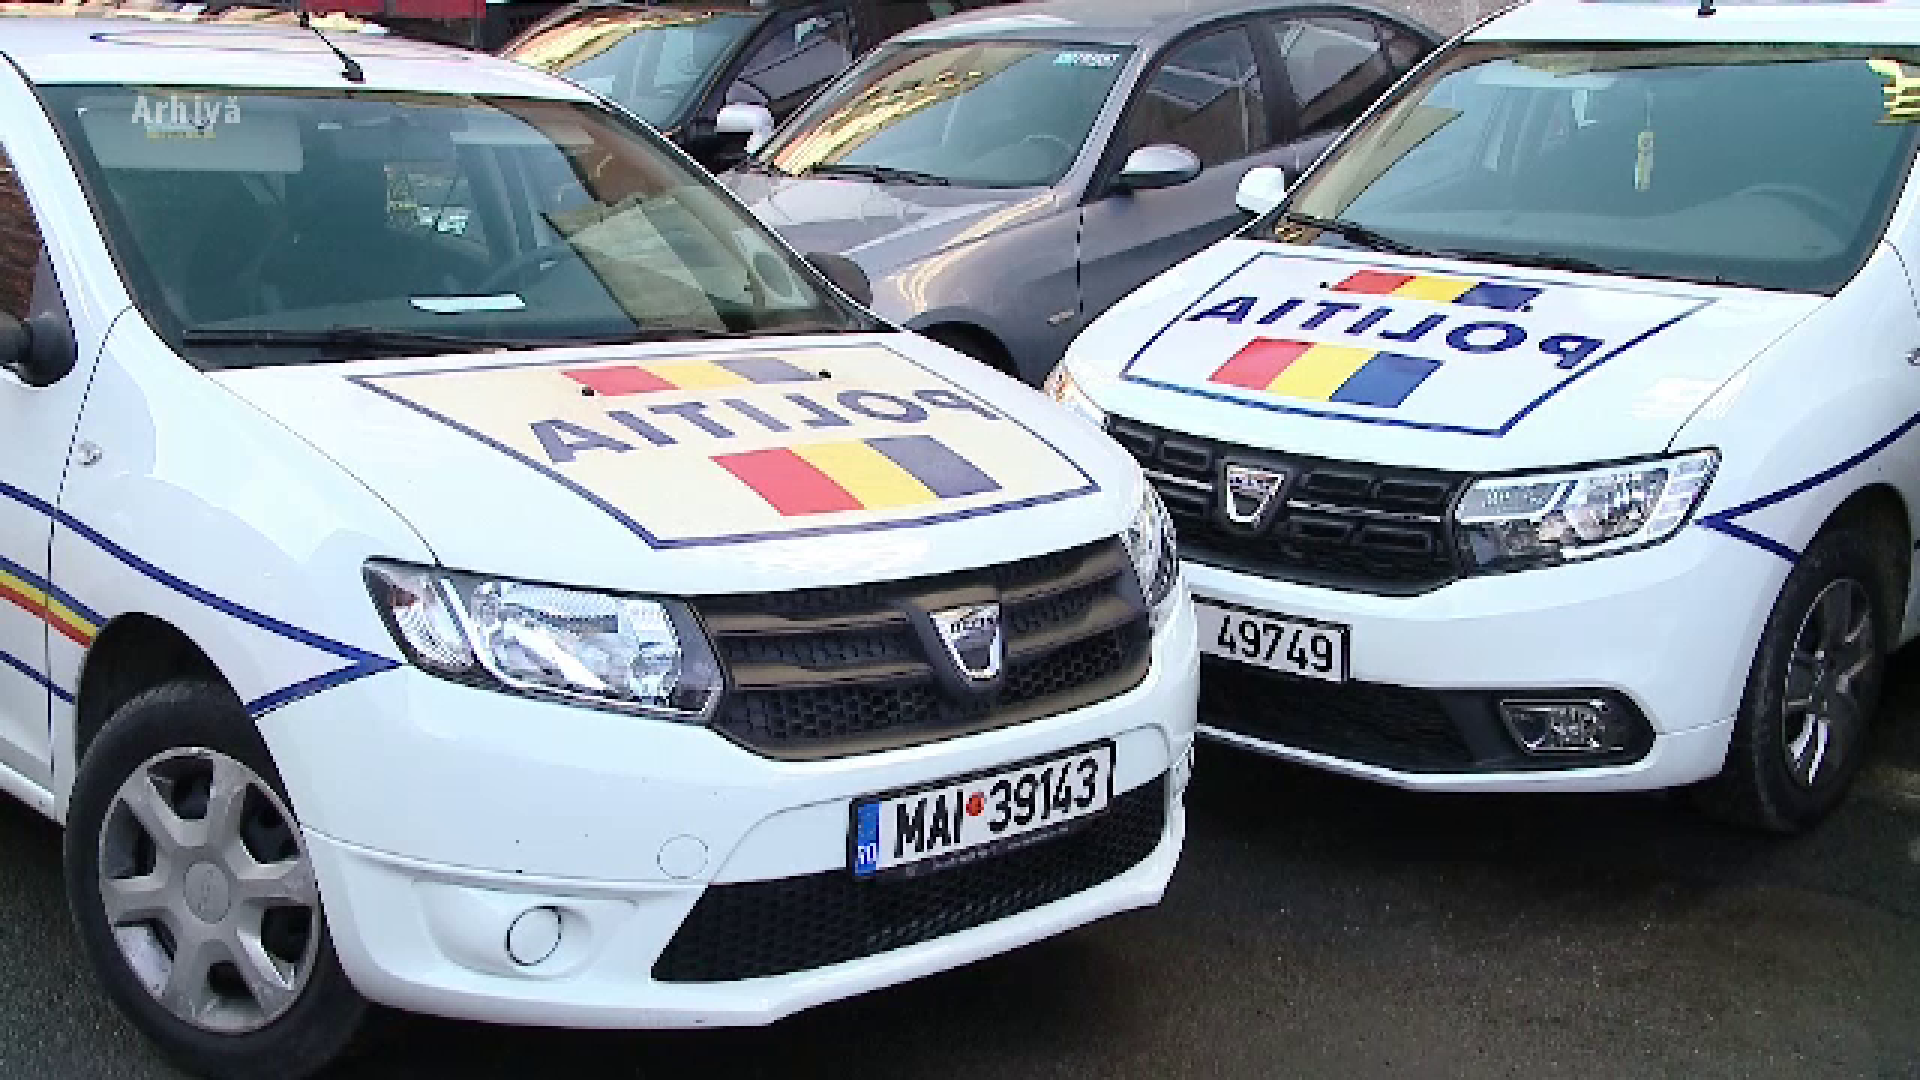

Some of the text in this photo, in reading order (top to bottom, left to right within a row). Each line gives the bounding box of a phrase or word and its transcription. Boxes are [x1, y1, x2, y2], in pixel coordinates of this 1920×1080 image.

[1218, 615, 1333, 672] 49749
[894, 789, 964, 859] MAI
[988, 756, 1099, 834] 39143
